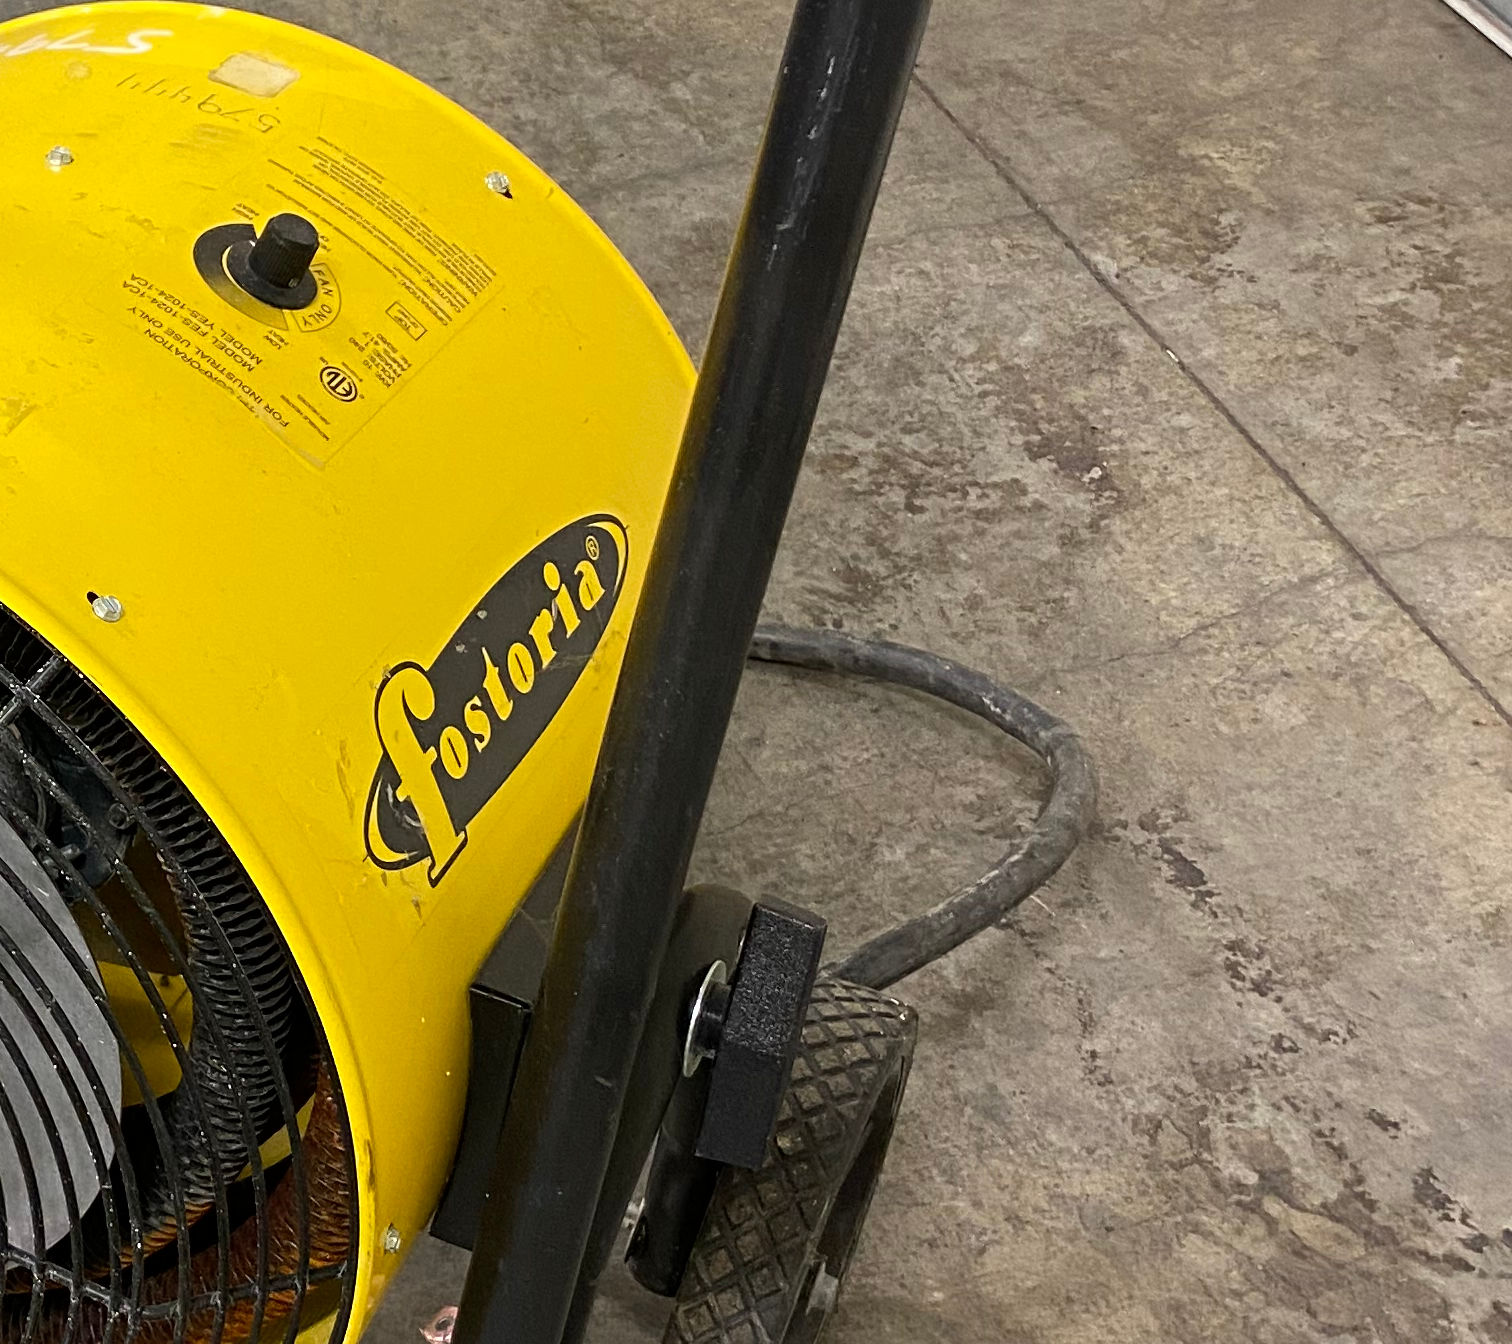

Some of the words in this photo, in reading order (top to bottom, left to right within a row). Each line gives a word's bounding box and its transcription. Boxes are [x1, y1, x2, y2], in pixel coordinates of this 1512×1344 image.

[315, 270, 334, 296] FAN
[123, 281, 209, 338] FES-1024-1CA
[128, 306, 164, 329] ONLY
[131, 273, 215, 331] YES-1024-1CA
[302, 304, 333, 327] ONLY
[164, 328, 192, 349] USE
[212, 336, 256, 373] MODEL
[221, 329, 264, 366] MODEL
[195, 347, 264, 405] INDUSTRIAL
[264, 404, 290, 428] FOR
[376, 559, 607, 885] fostoria
